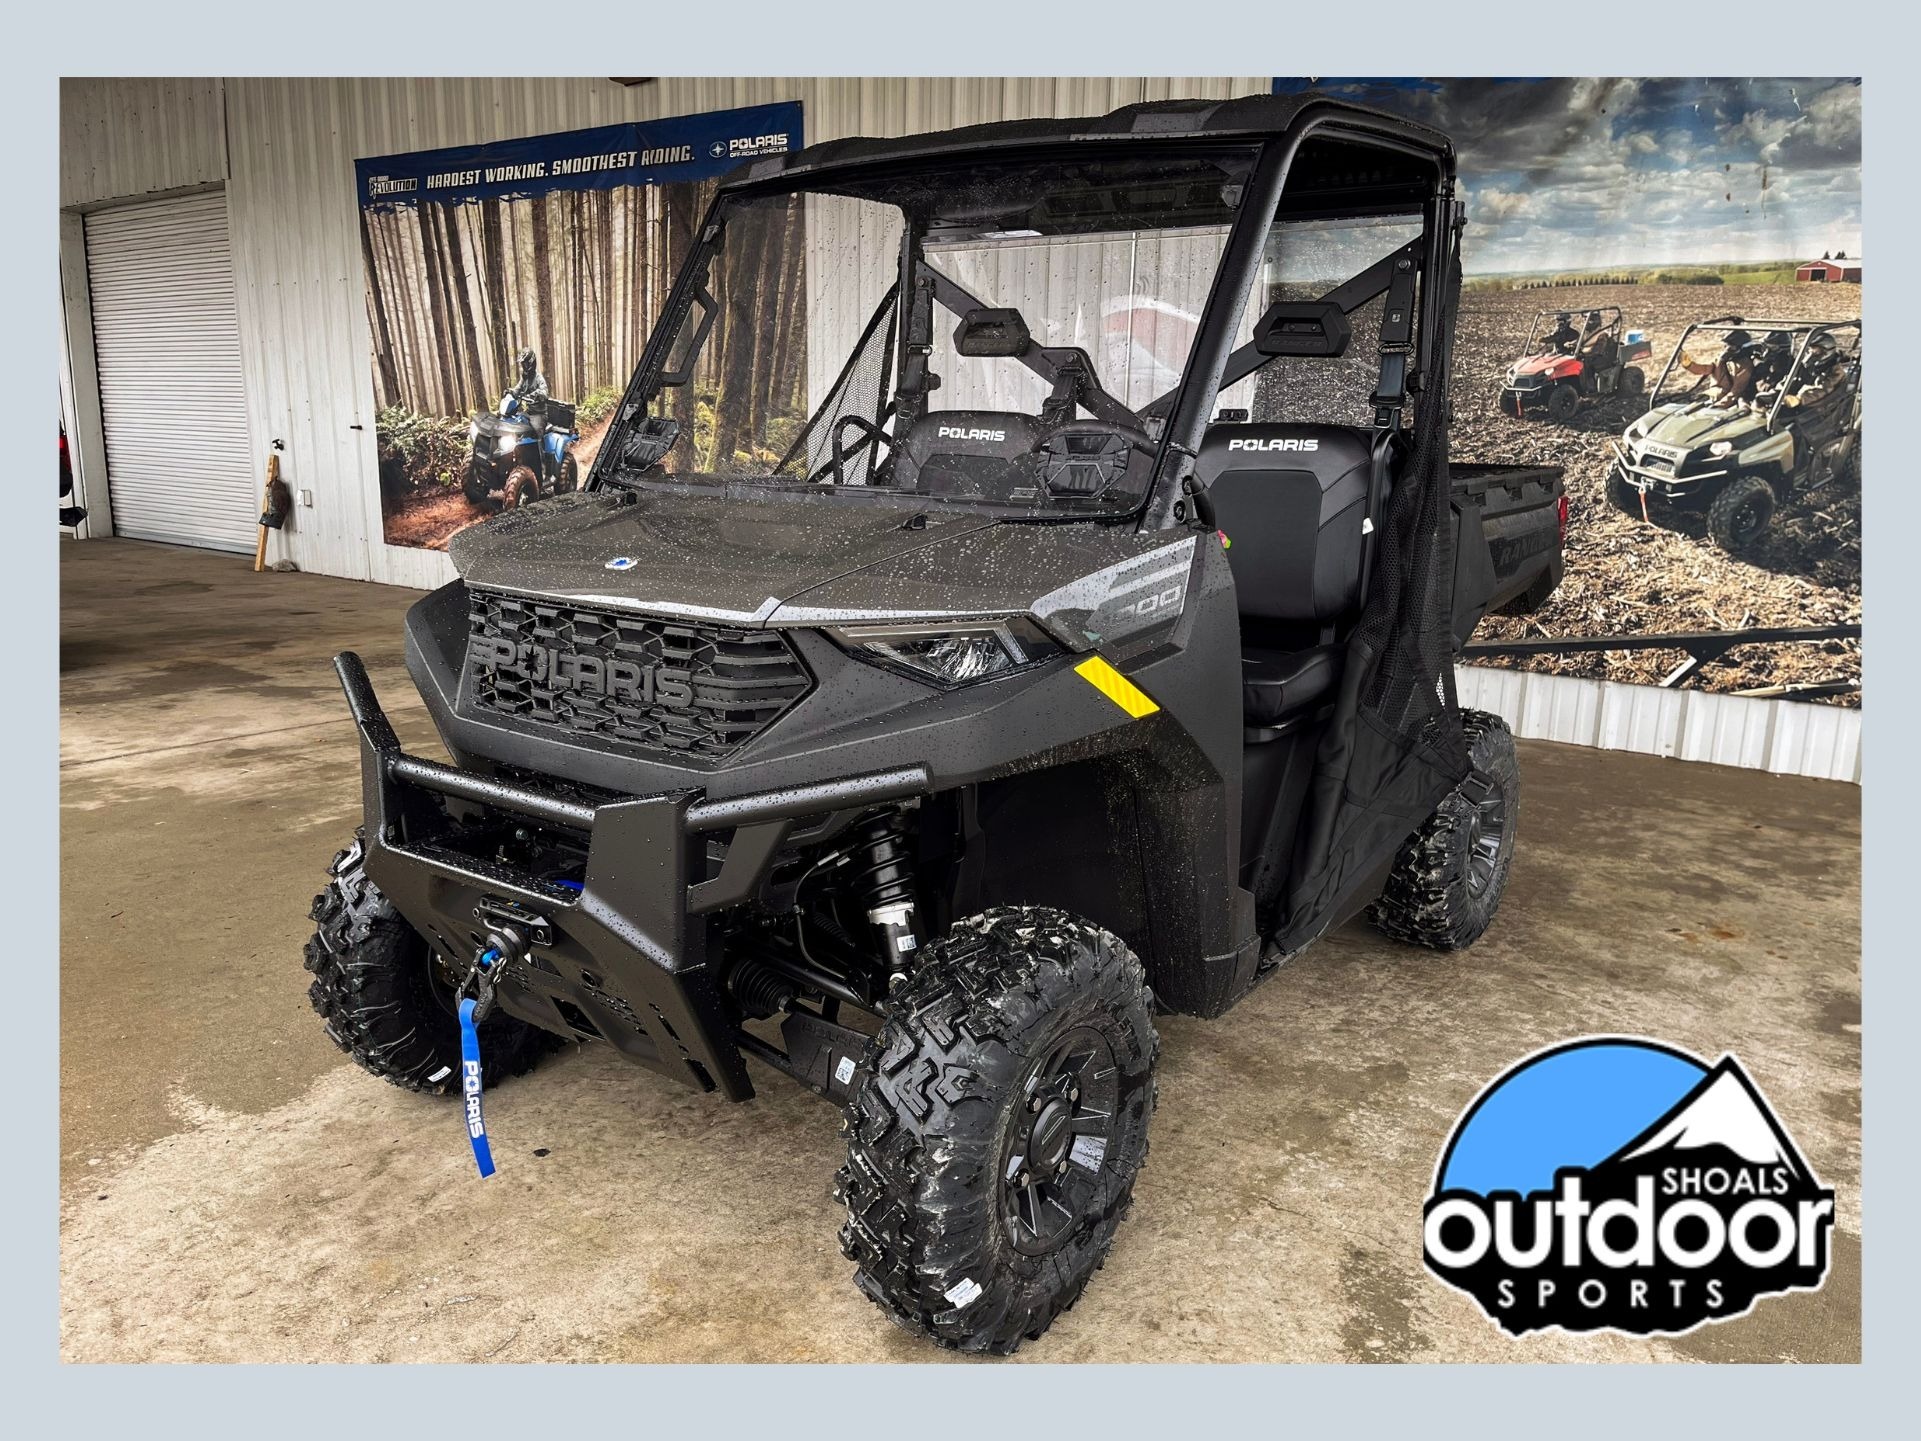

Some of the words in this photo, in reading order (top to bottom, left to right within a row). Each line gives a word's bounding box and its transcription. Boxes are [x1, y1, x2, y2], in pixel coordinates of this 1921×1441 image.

[729, 133, 788, 151] POLARIS
[729, 150, 759, 158] OFF-ROAD
[759, 146, 788, 155] VEHICLES
[426, 169, 482, 189] HARDEST
[485, 162, 549, 183] WORKING.
[551, 151, 638, 176] SMOOTHEST
[937, 426, 1006, 442] POLARIS
[1227, 439, 1319, 452] POLARIS
[489, 636, 693, 709] POLARIS
[464, 1060, 485, 1139] POLARIS
